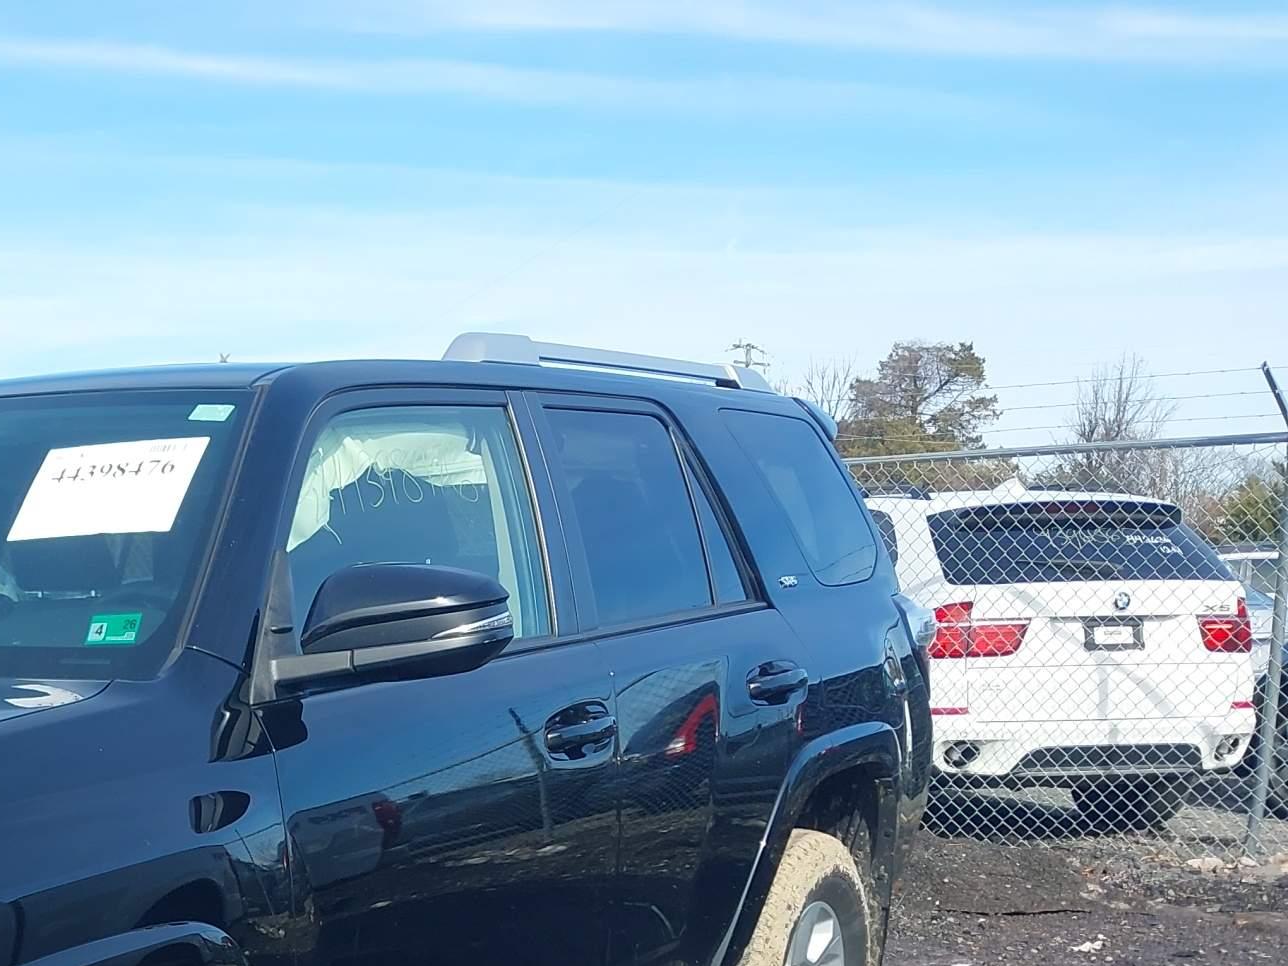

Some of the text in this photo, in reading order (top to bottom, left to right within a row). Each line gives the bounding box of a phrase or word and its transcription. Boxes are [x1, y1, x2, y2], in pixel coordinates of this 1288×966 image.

[51, 459, 175, 483] 44398476
[1202, 604, 1231, 613] X5
[95, 623, 104, 637] 4
